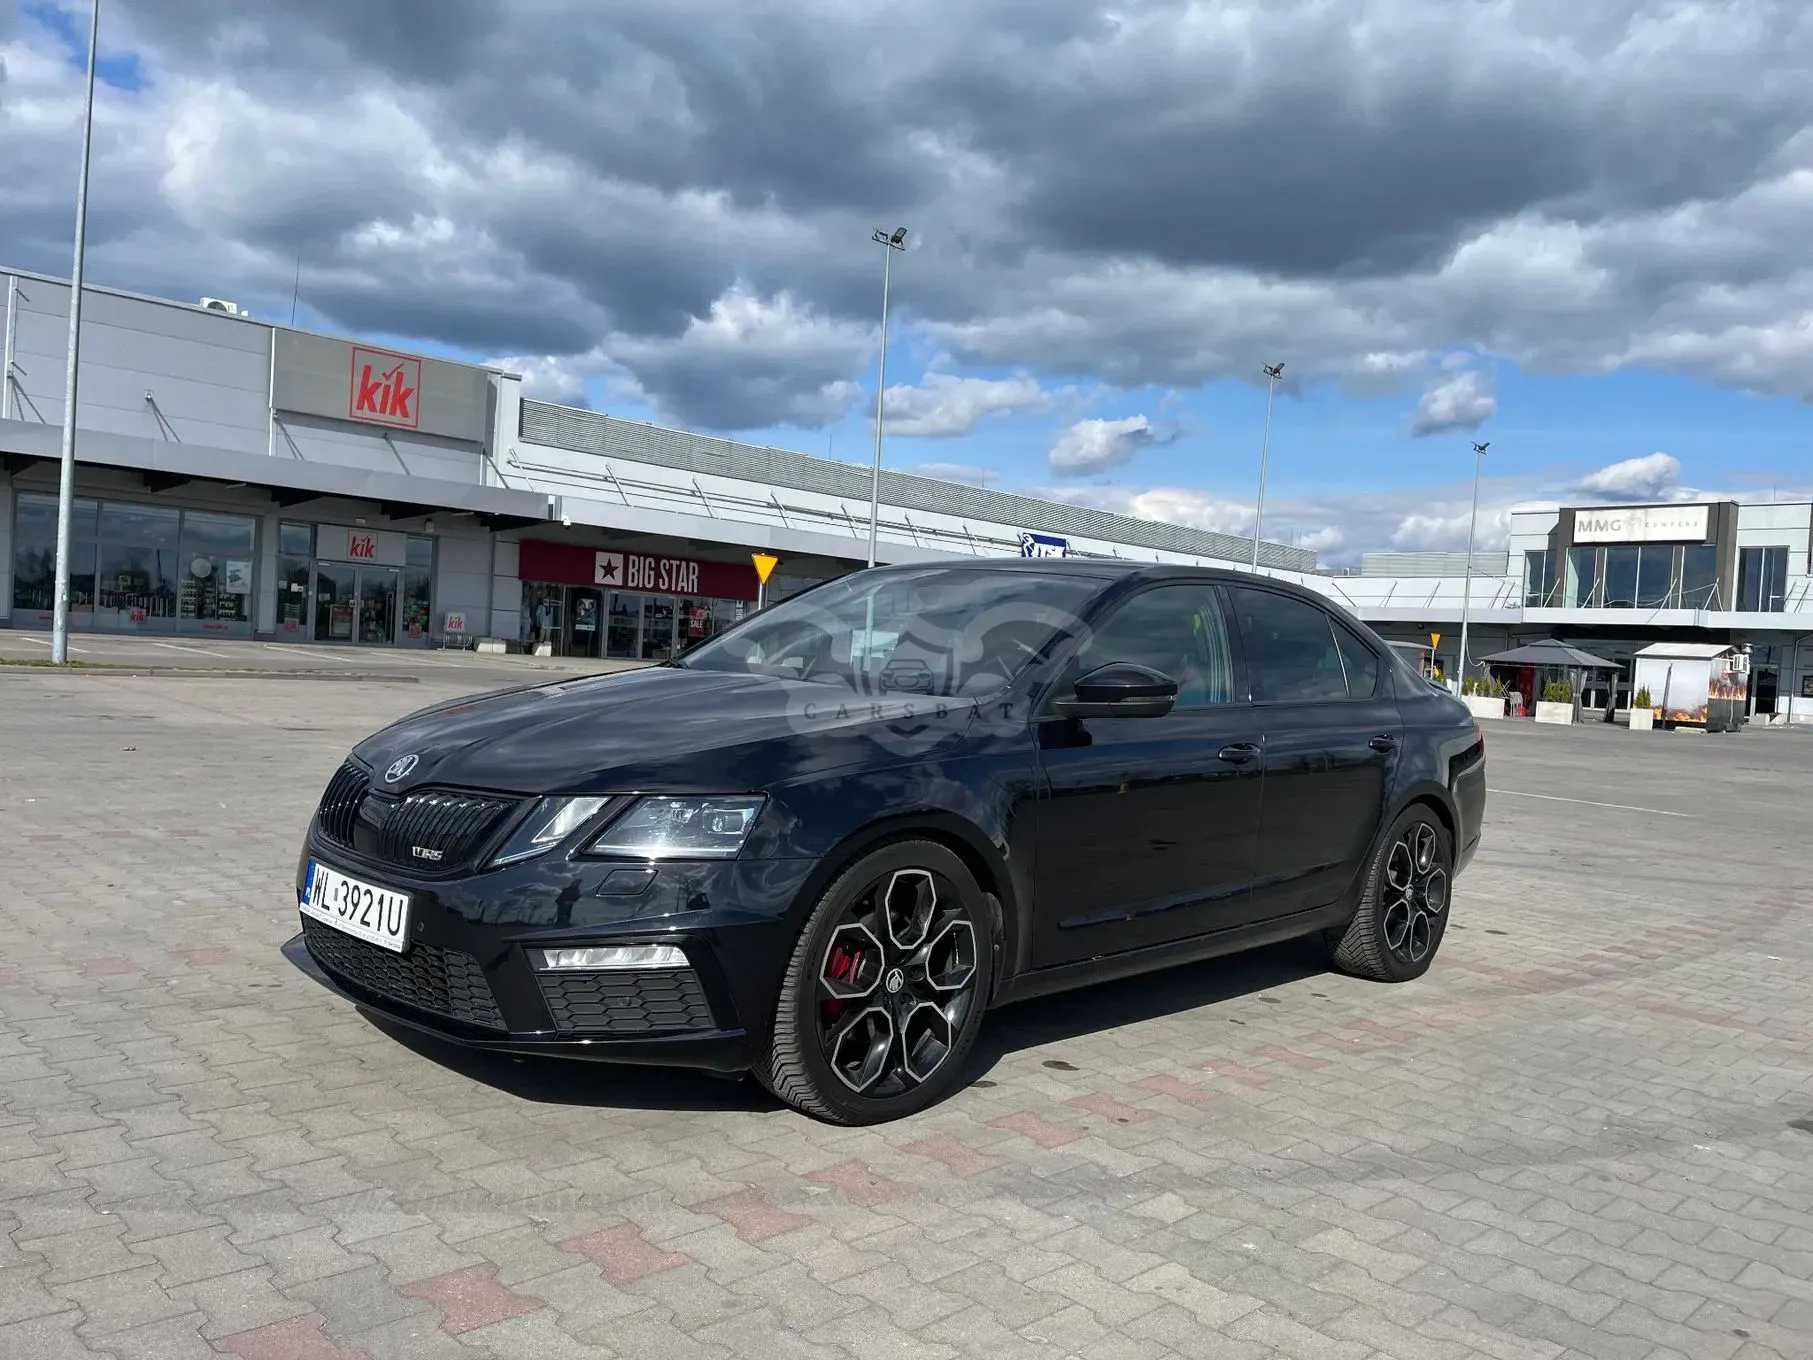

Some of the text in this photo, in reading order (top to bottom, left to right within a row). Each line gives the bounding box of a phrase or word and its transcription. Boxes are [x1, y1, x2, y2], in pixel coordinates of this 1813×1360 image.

[356, 364, 415, 418] kik
[1578, 519, 1621, 532] MMG
[350, 535, 375, 558] kik
[627, 555, 699, 593] BIG STAR
[448, 615, 463, 629] kik
[690, 619, 704, 628] SALE
[312, 867, 403, 936] WL 3921U
